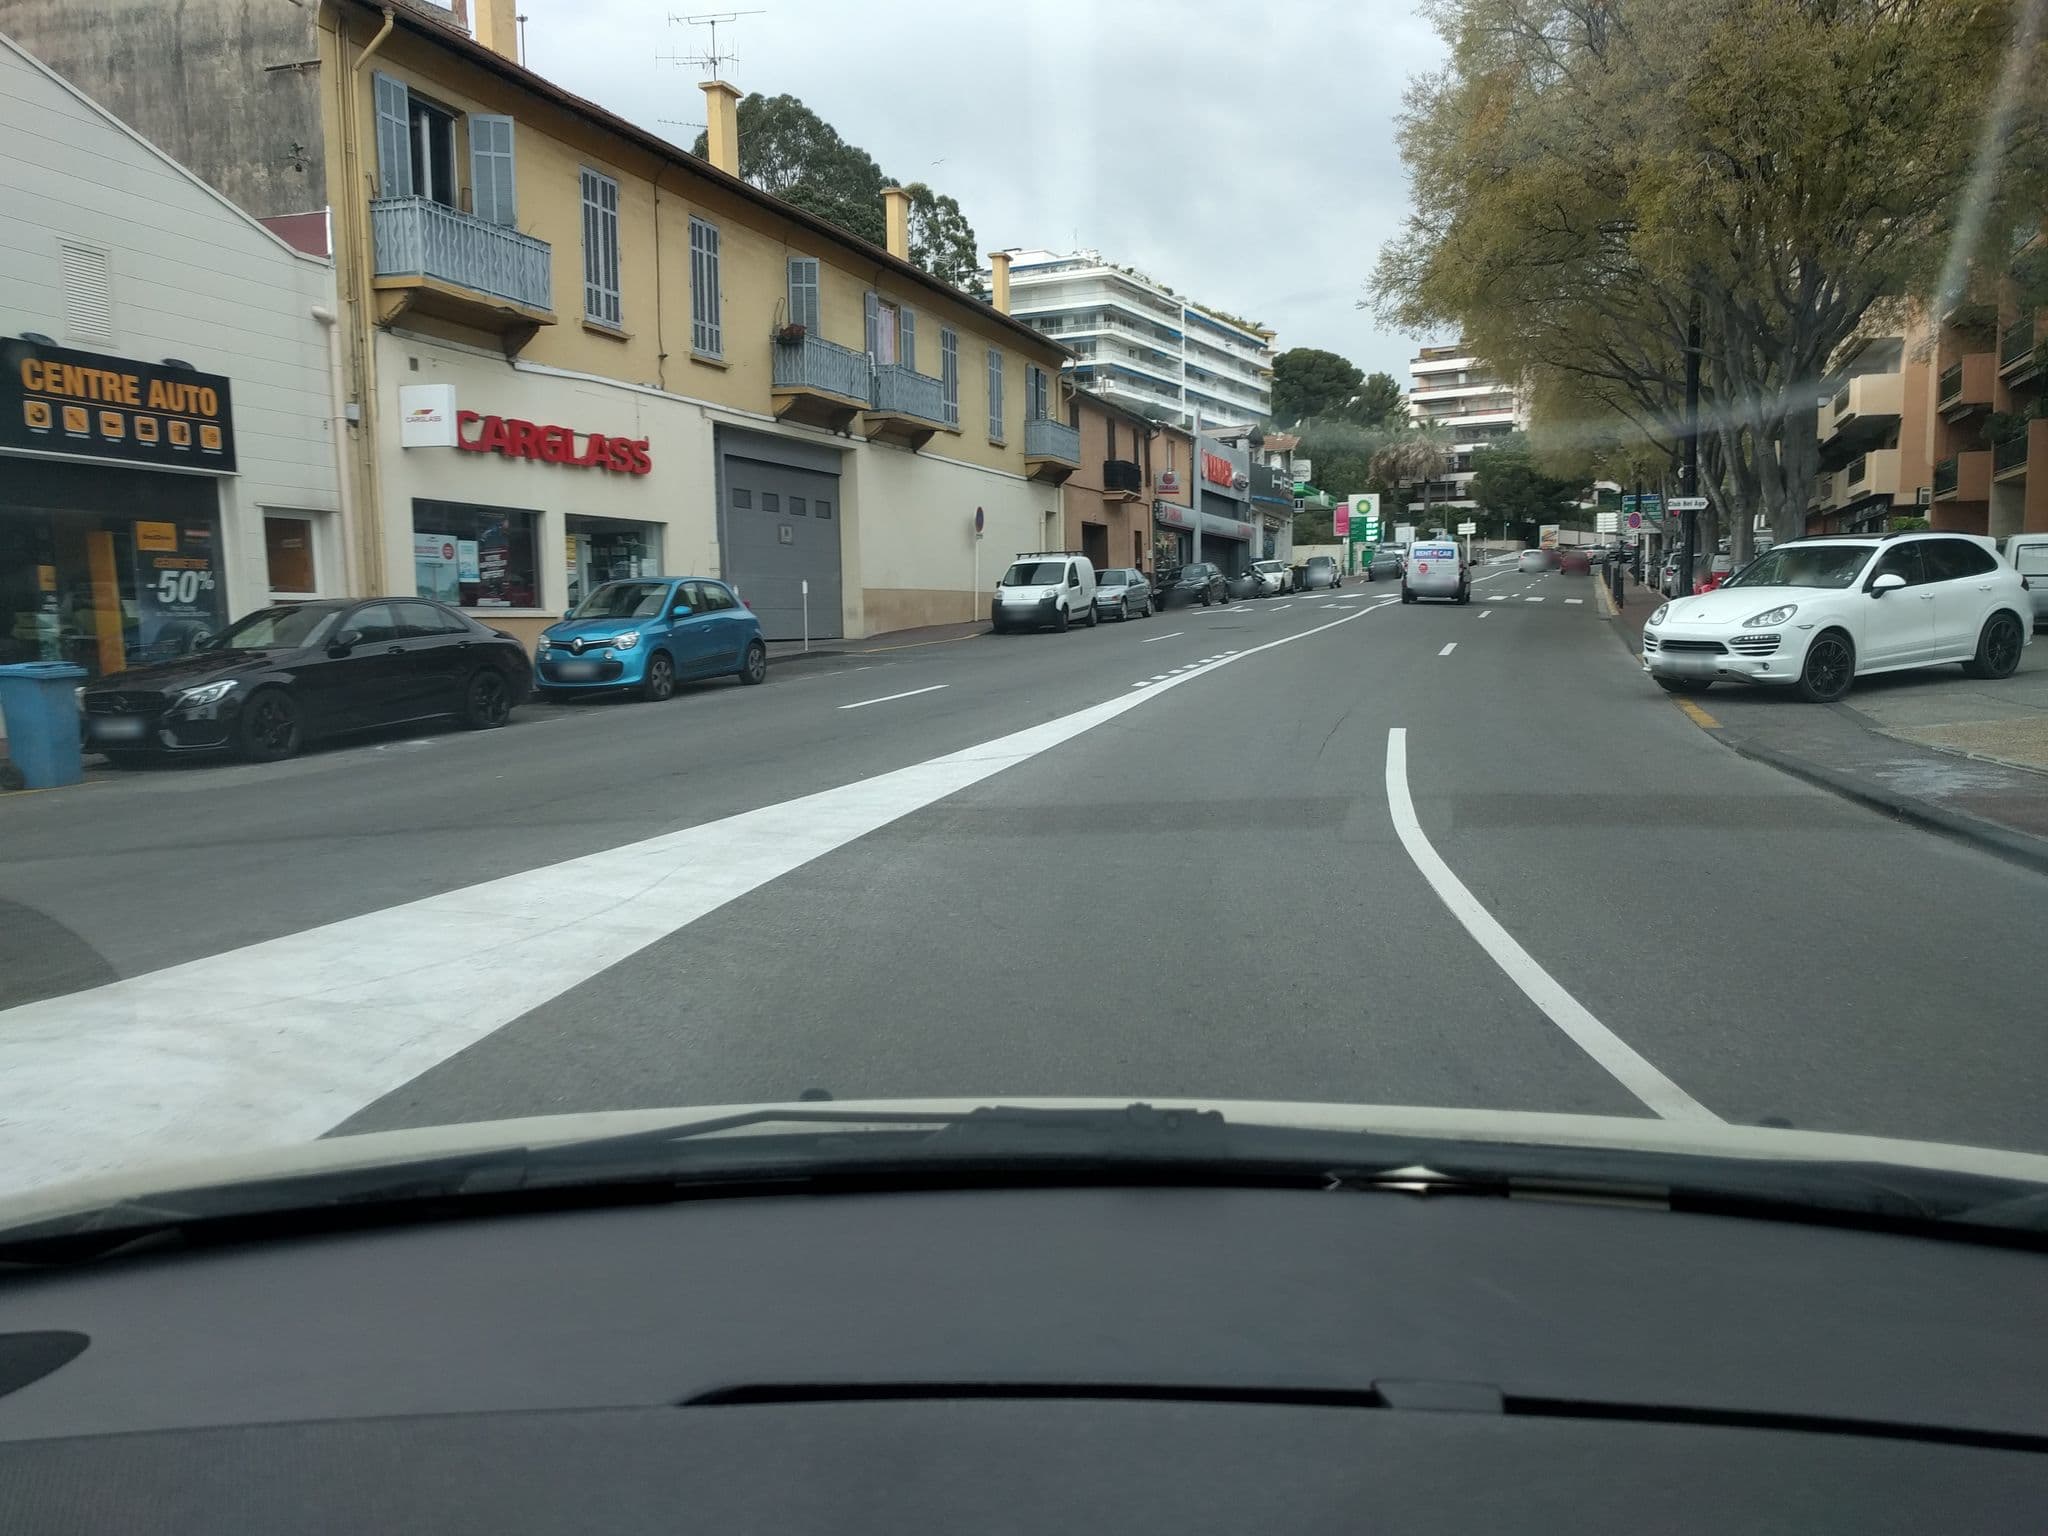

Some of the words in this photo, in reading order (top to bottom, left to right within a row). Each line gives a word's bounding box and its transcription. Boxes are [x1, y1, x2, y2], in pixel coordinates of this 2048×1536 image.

[20, 358, 141, 405] CENTRE
[148, 379, 218, 417] AUTO
[457, 410, 652, 475] CARGLASS
[145, 570, 215, 603] -50%
